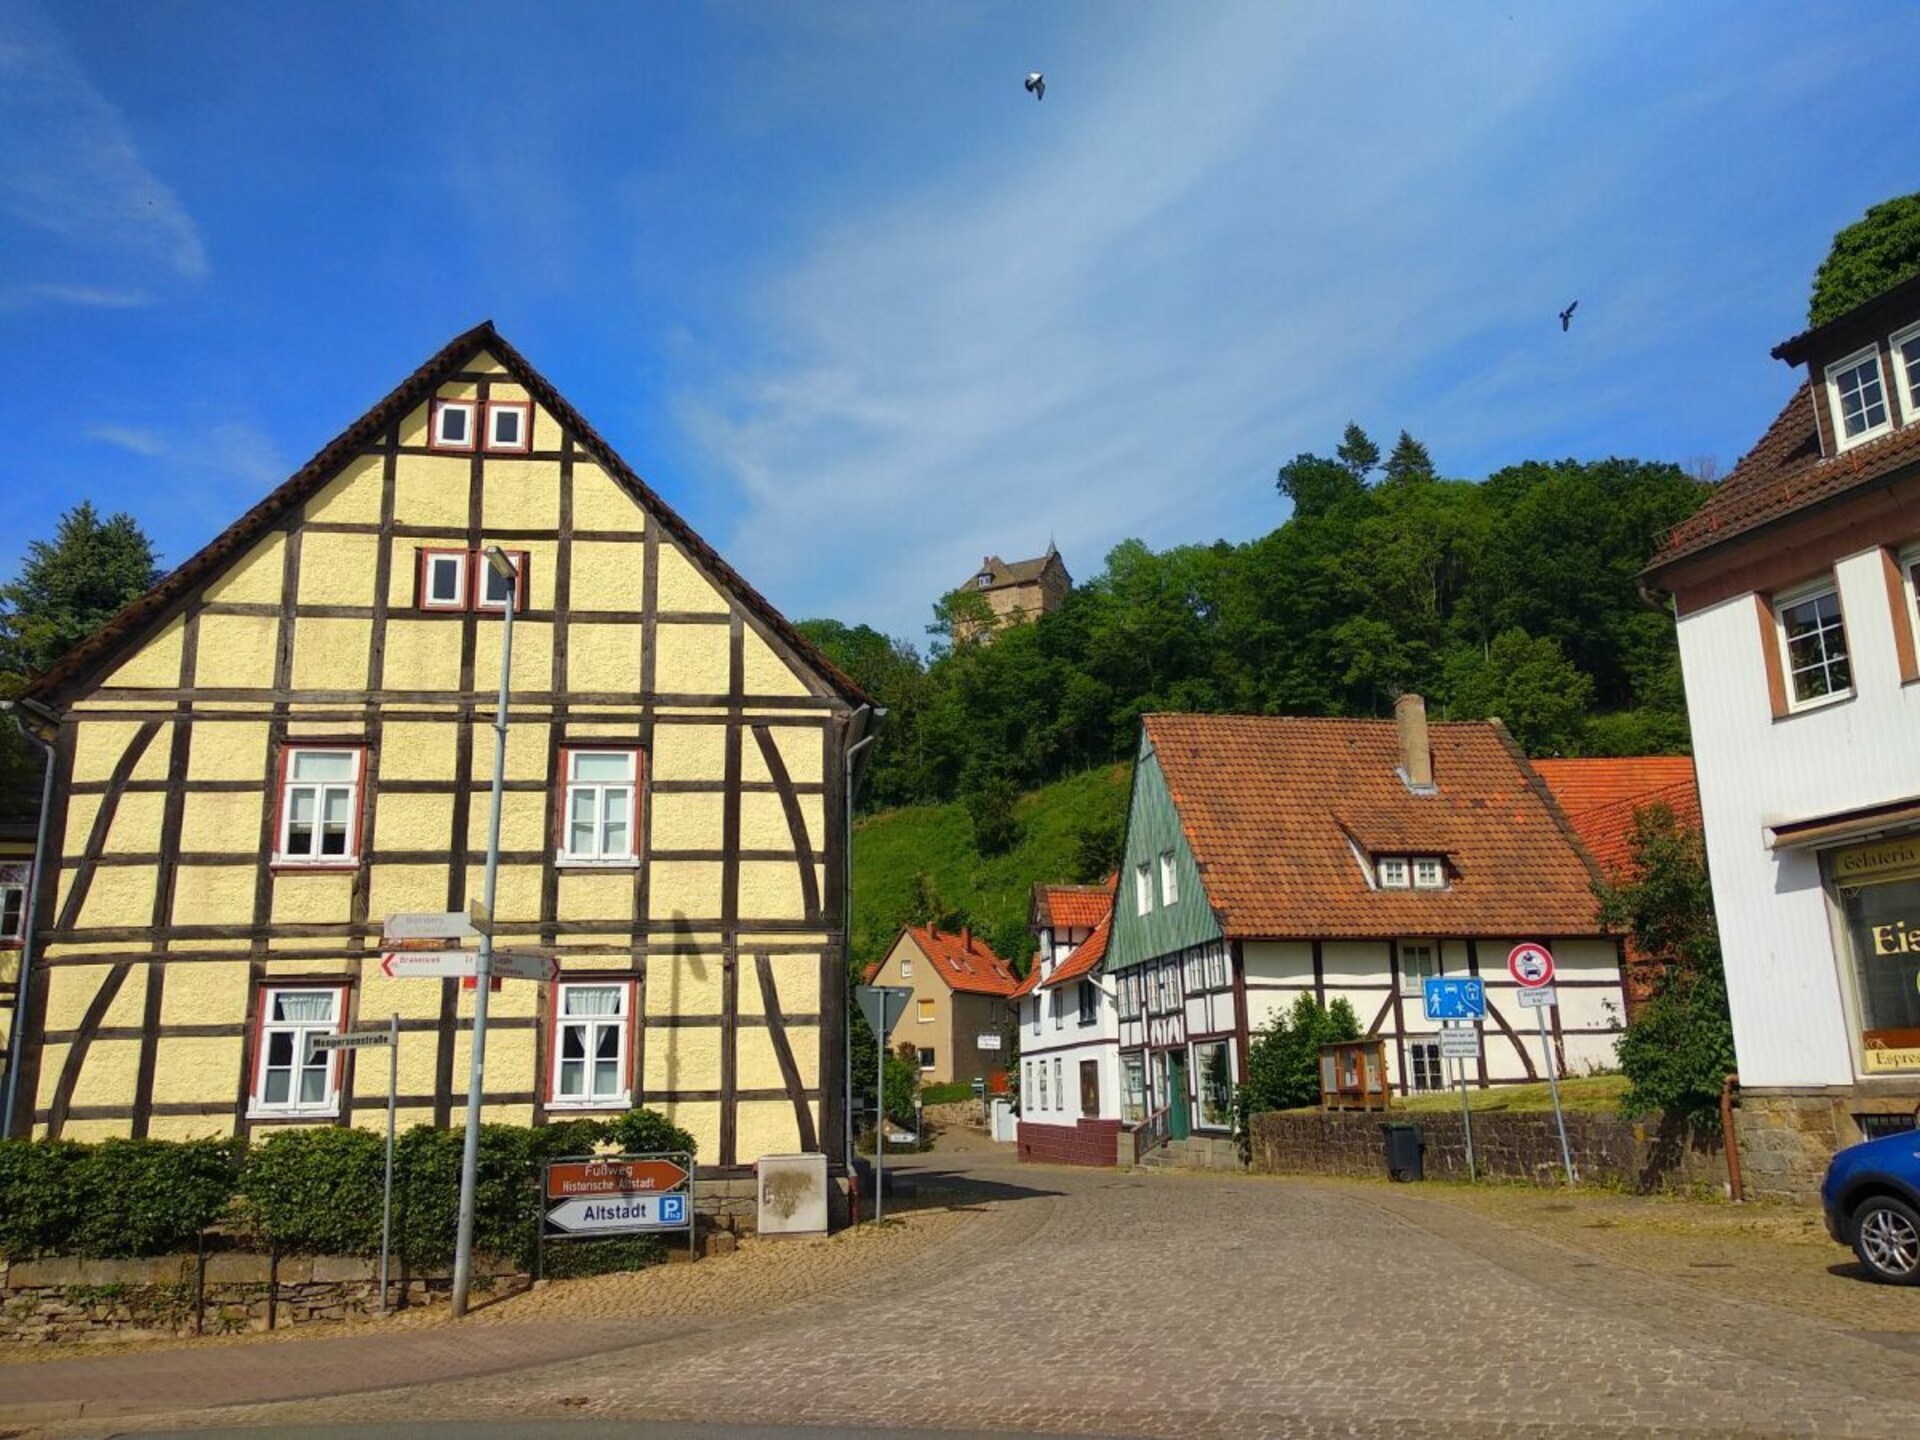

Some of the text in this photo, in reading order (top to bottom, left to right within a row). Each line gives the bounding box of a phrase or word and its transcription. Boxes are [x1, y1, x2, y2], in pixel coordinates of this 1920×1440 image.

[585, 1164, 633, 1177] Fußweg
[562, 1179, 614, 1192] Historische
[619, 1177, 655, 1189] Altstadt
[584, 1203, 647, 1221] Altstadt
